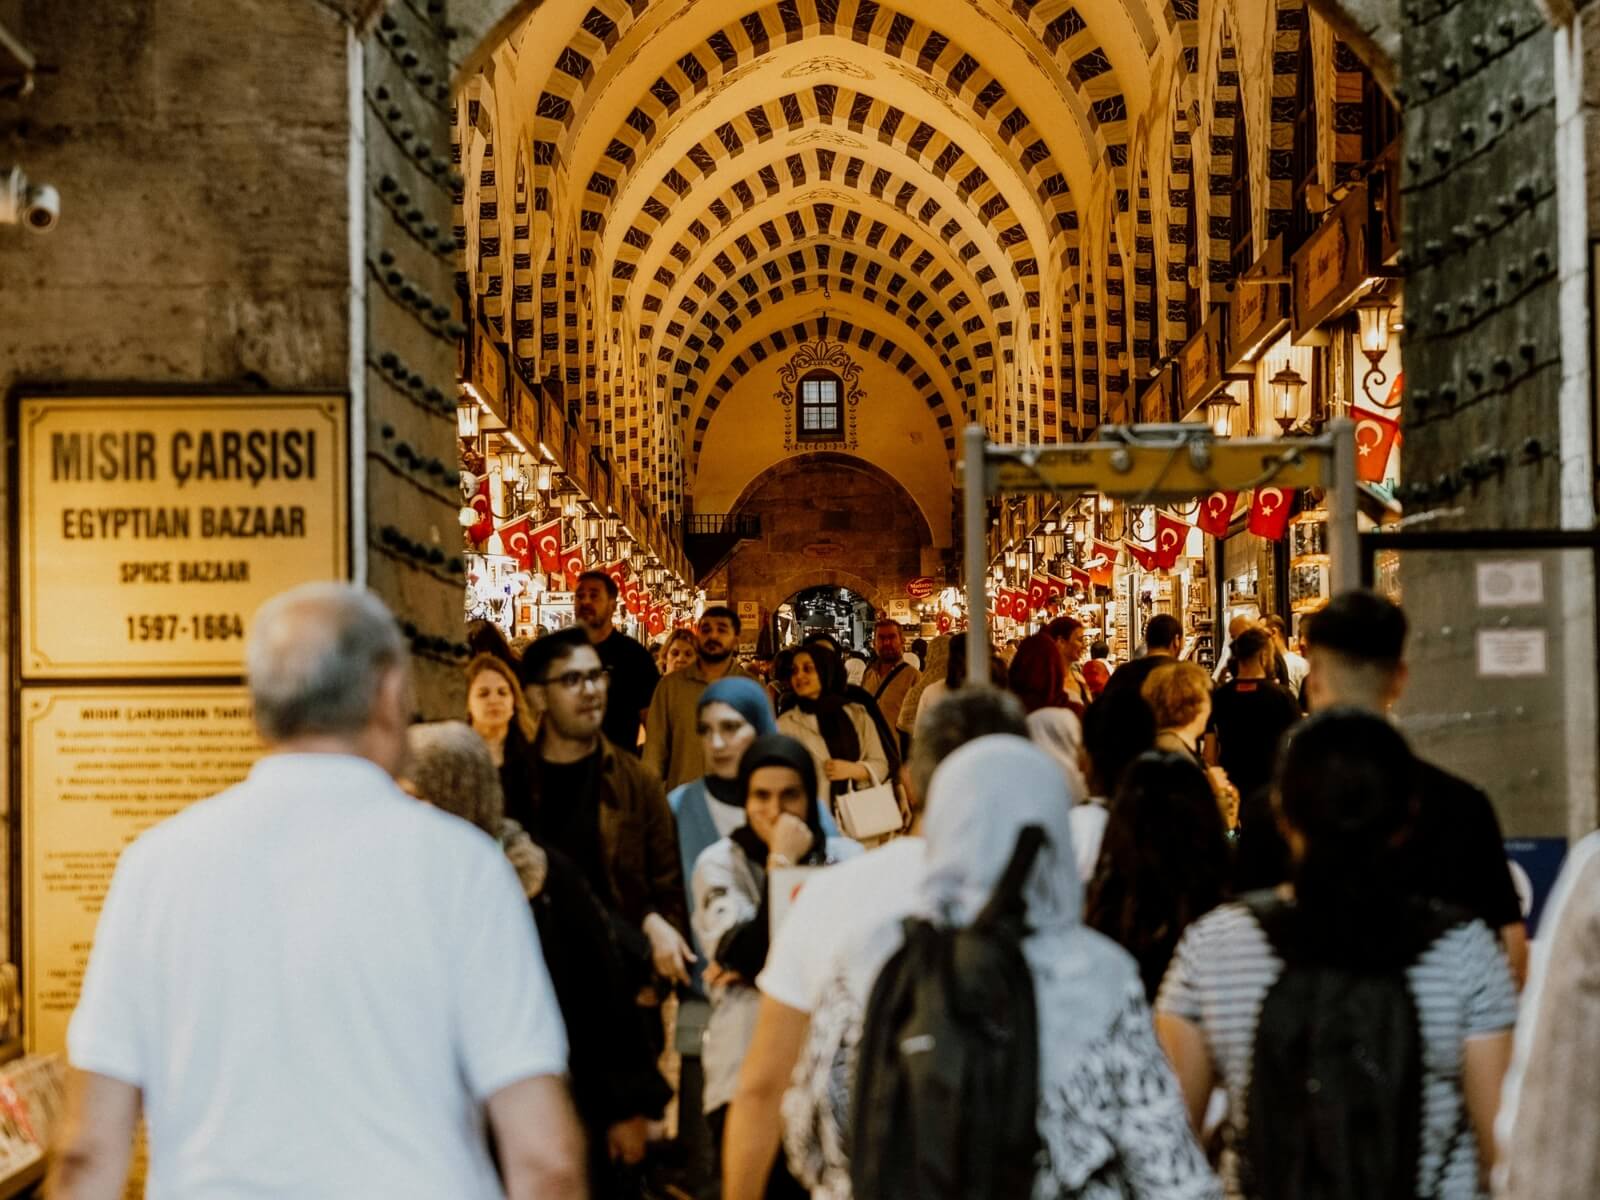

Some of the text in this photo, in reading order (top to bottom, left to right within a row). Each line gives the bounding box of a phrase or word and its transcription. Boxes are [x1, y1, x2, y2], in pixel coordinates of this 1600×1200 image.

[51, 428, 317, 488] MISIR ÇARŞISI
[62, 505, 307, 540] EGYPTIAN BAZAAR
[119, 560, 250, 584] SPICE BAZAAR
[127, 613, 243, 642] 1597-1664
